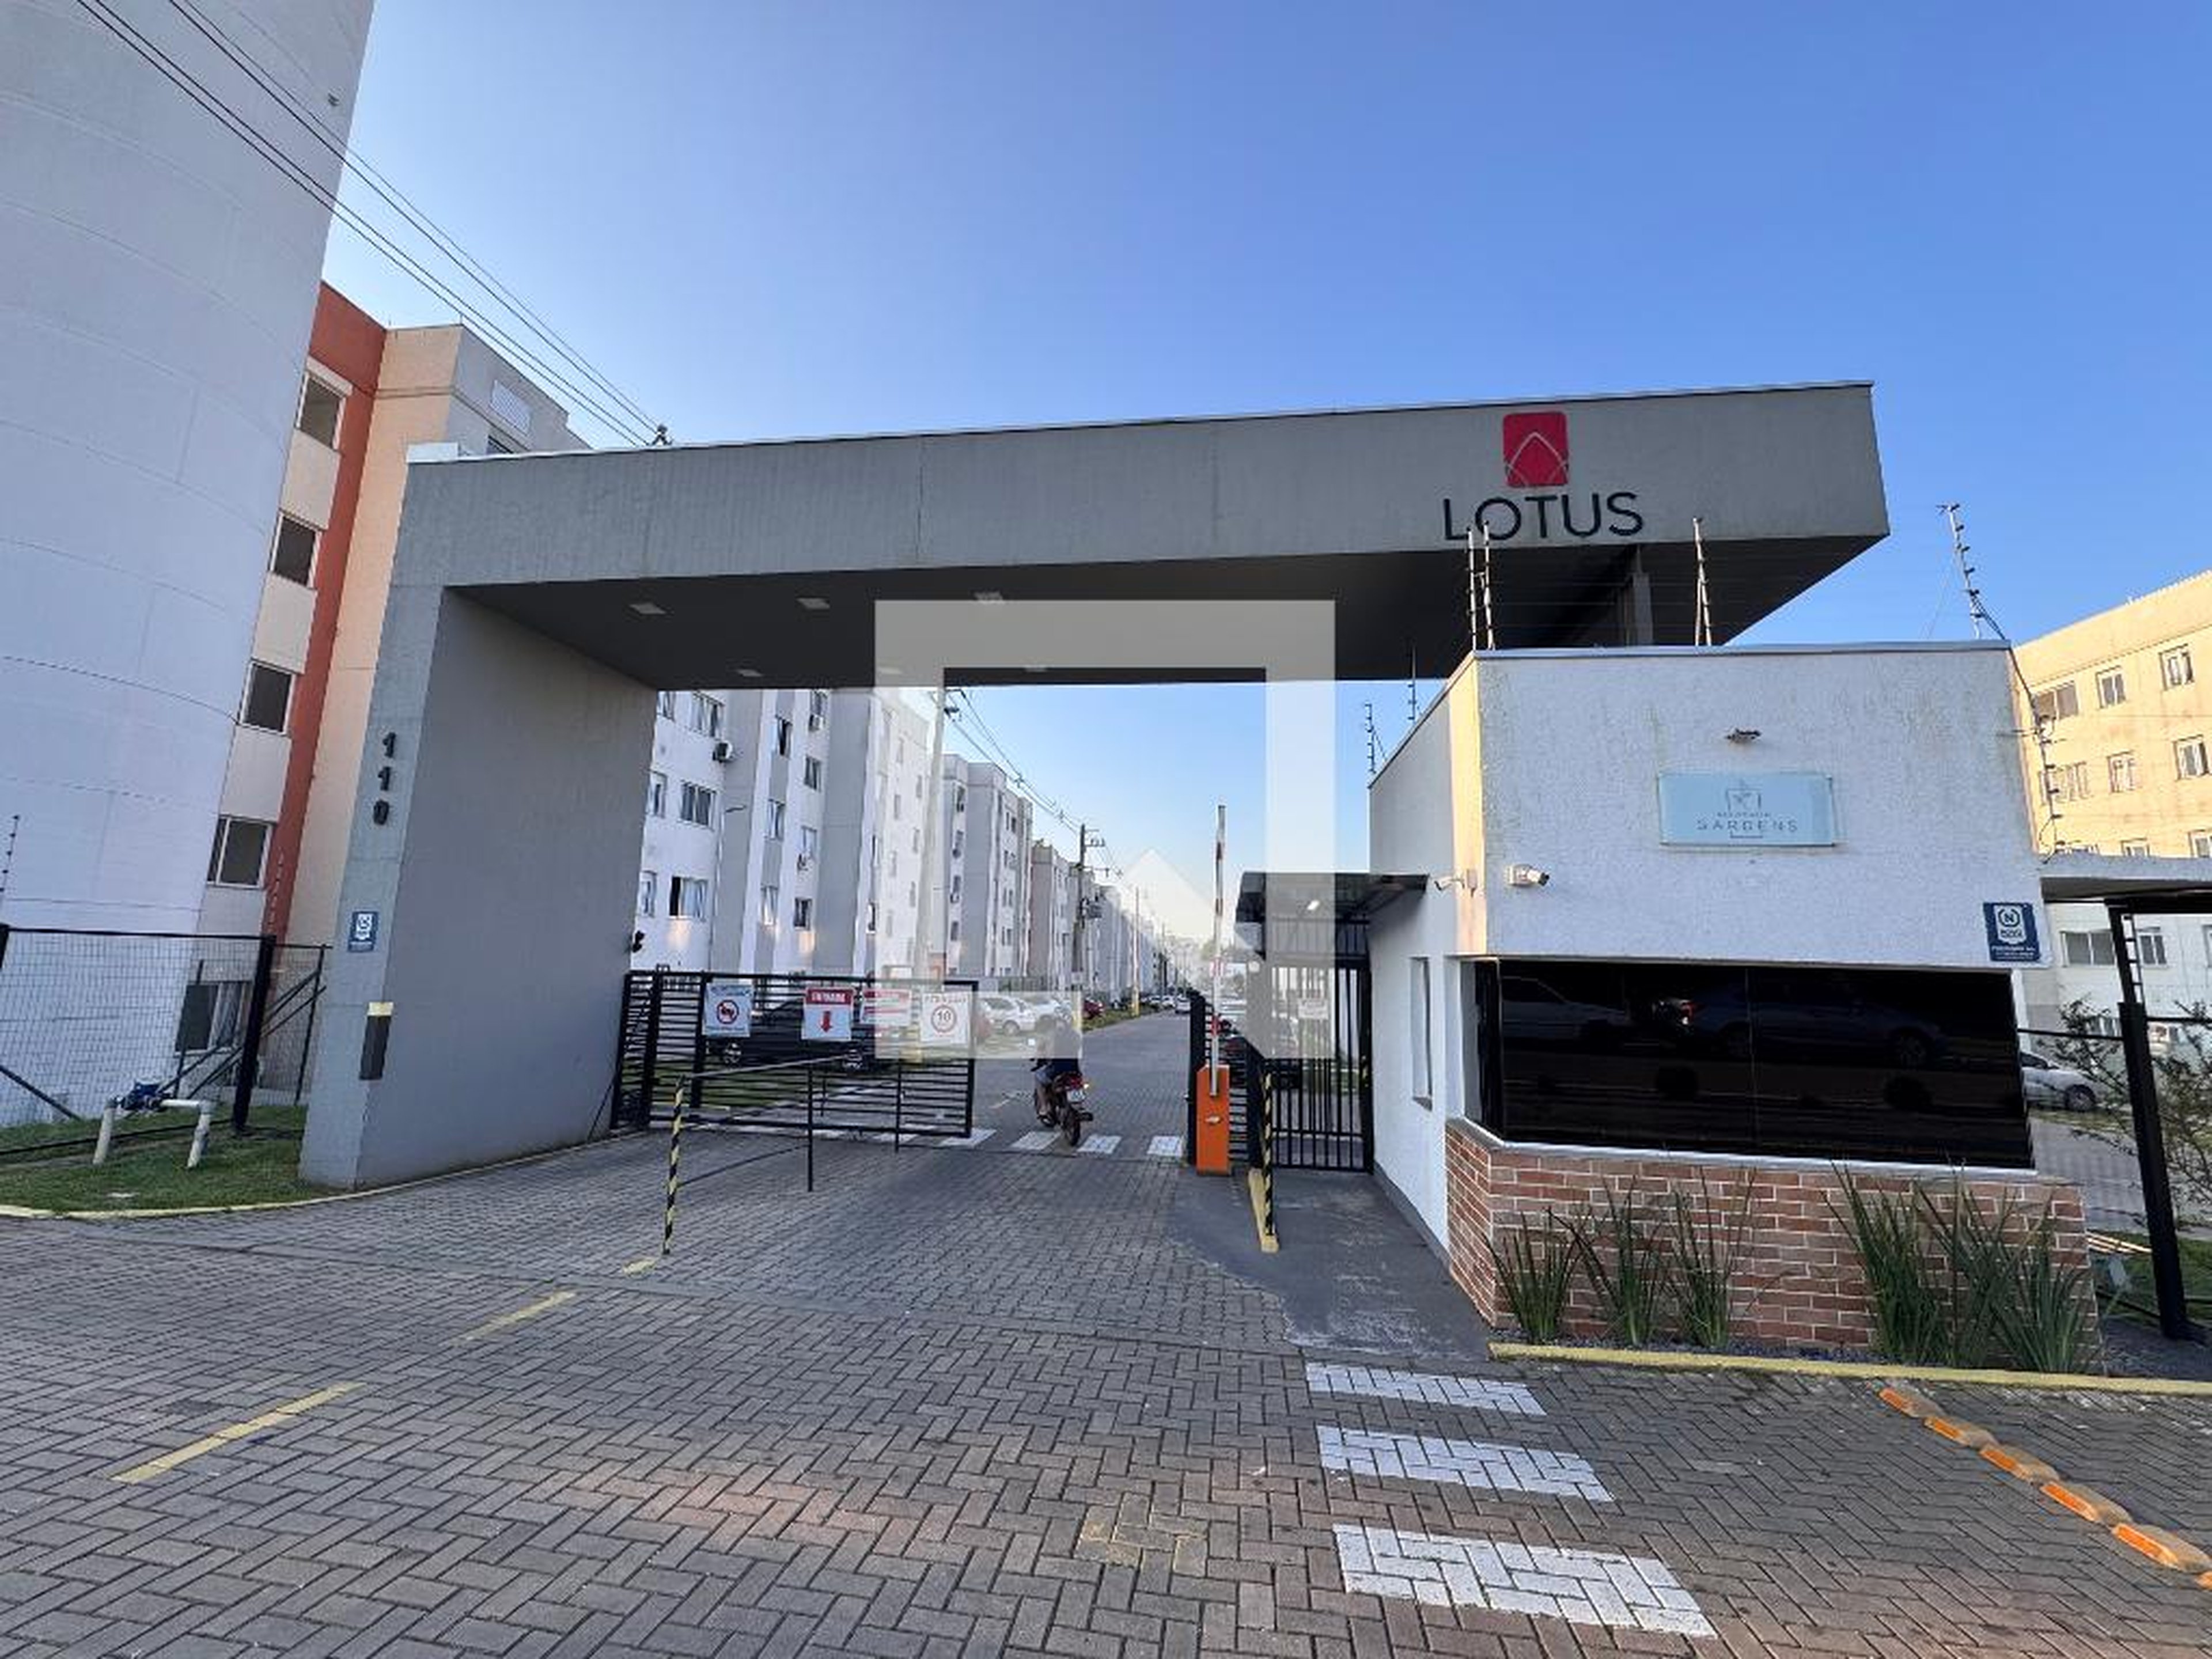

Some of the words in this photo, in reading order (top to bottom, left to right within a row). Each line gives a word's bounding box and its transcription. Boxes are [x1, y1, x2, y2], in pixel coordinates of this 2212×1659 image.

[1442, 491, 1645, 541] LOTUS
[373, 731, 397, 826] 110
[937, 1010, 952, 1022] 10
